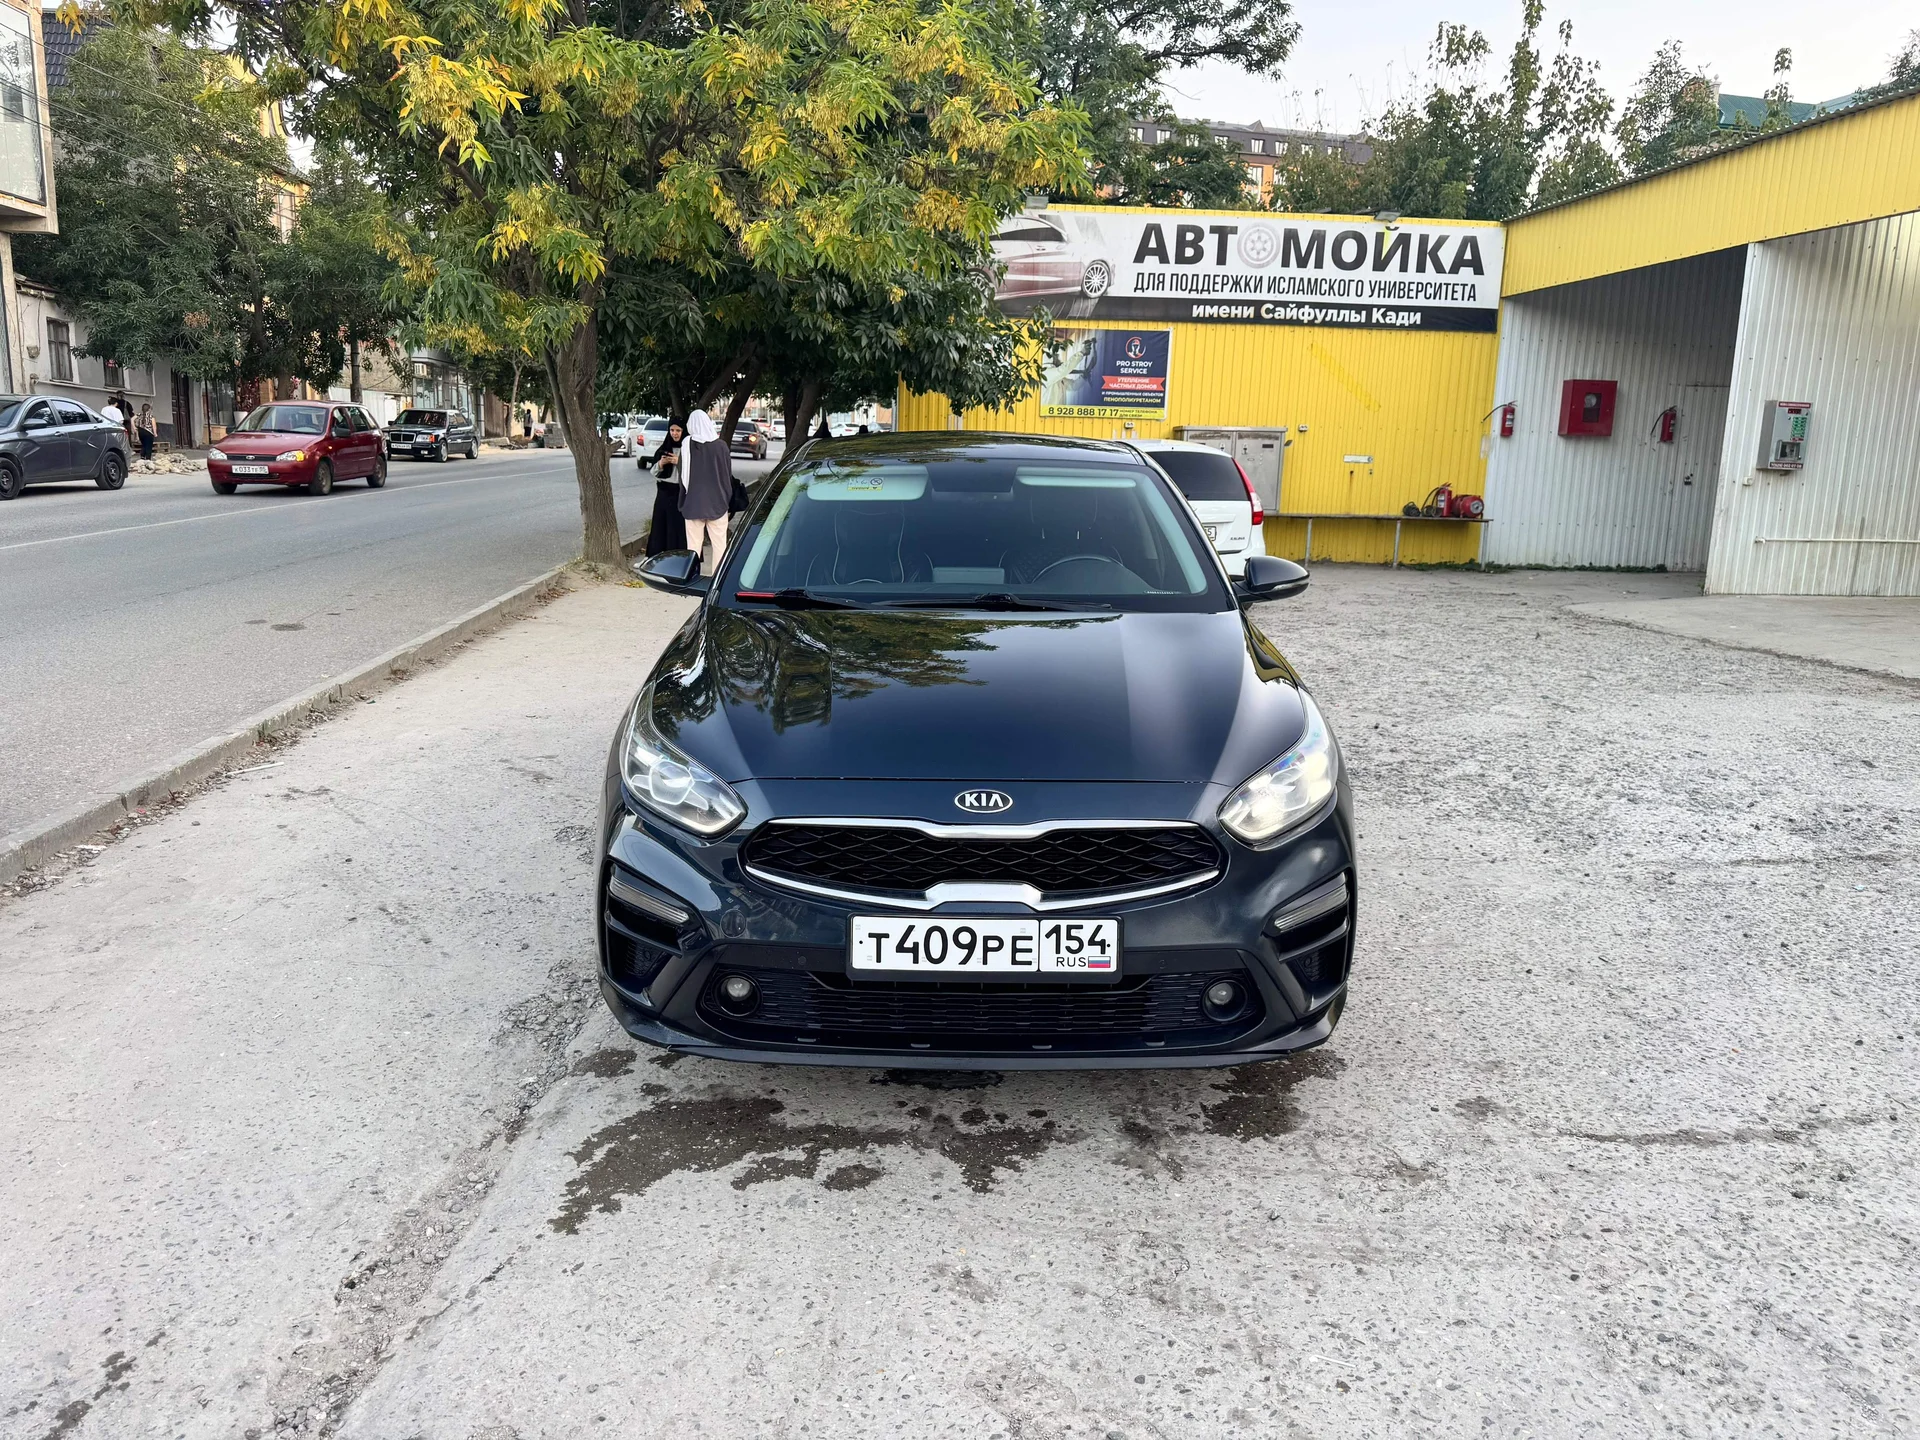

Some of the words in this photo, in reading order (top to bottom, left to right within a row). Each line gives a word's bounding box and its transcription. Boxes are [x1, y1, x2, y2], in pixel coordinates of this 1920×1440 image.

[1133, 272, 1166, 293] ДЛЯ
[1169, 273, 1264, 295] ПОДДЕРЖКИ
[1267, 276, 1364, 298] ИСЛАМСКОГО
[1368, 280, 1477, 302] УНИВЕРСИТЕТА
[1192, 304, 1255, 319] имени
[1260, 303, 1366, 324] Сайфуллы
[1371, 307, 1422, 327] Кади
[1131, 360, 1153, 368] STROY
[1120, 367, 1148, 375] SERVICE
[1048, 407, 1055, 415] 8
[1056, 407, 1075, 416] 928
[1077, 408, 1095, 416] 888
[1097, 408, 1107, 417] 17
[1109, 409, 1119, 417] 17
[964, 793, 1004, 807] KIA
[867, 924, 1034, 966] Т409РЕ
[1044, 924, 1107, 955] 154
[1056, 956, 1087, 967] RUS
